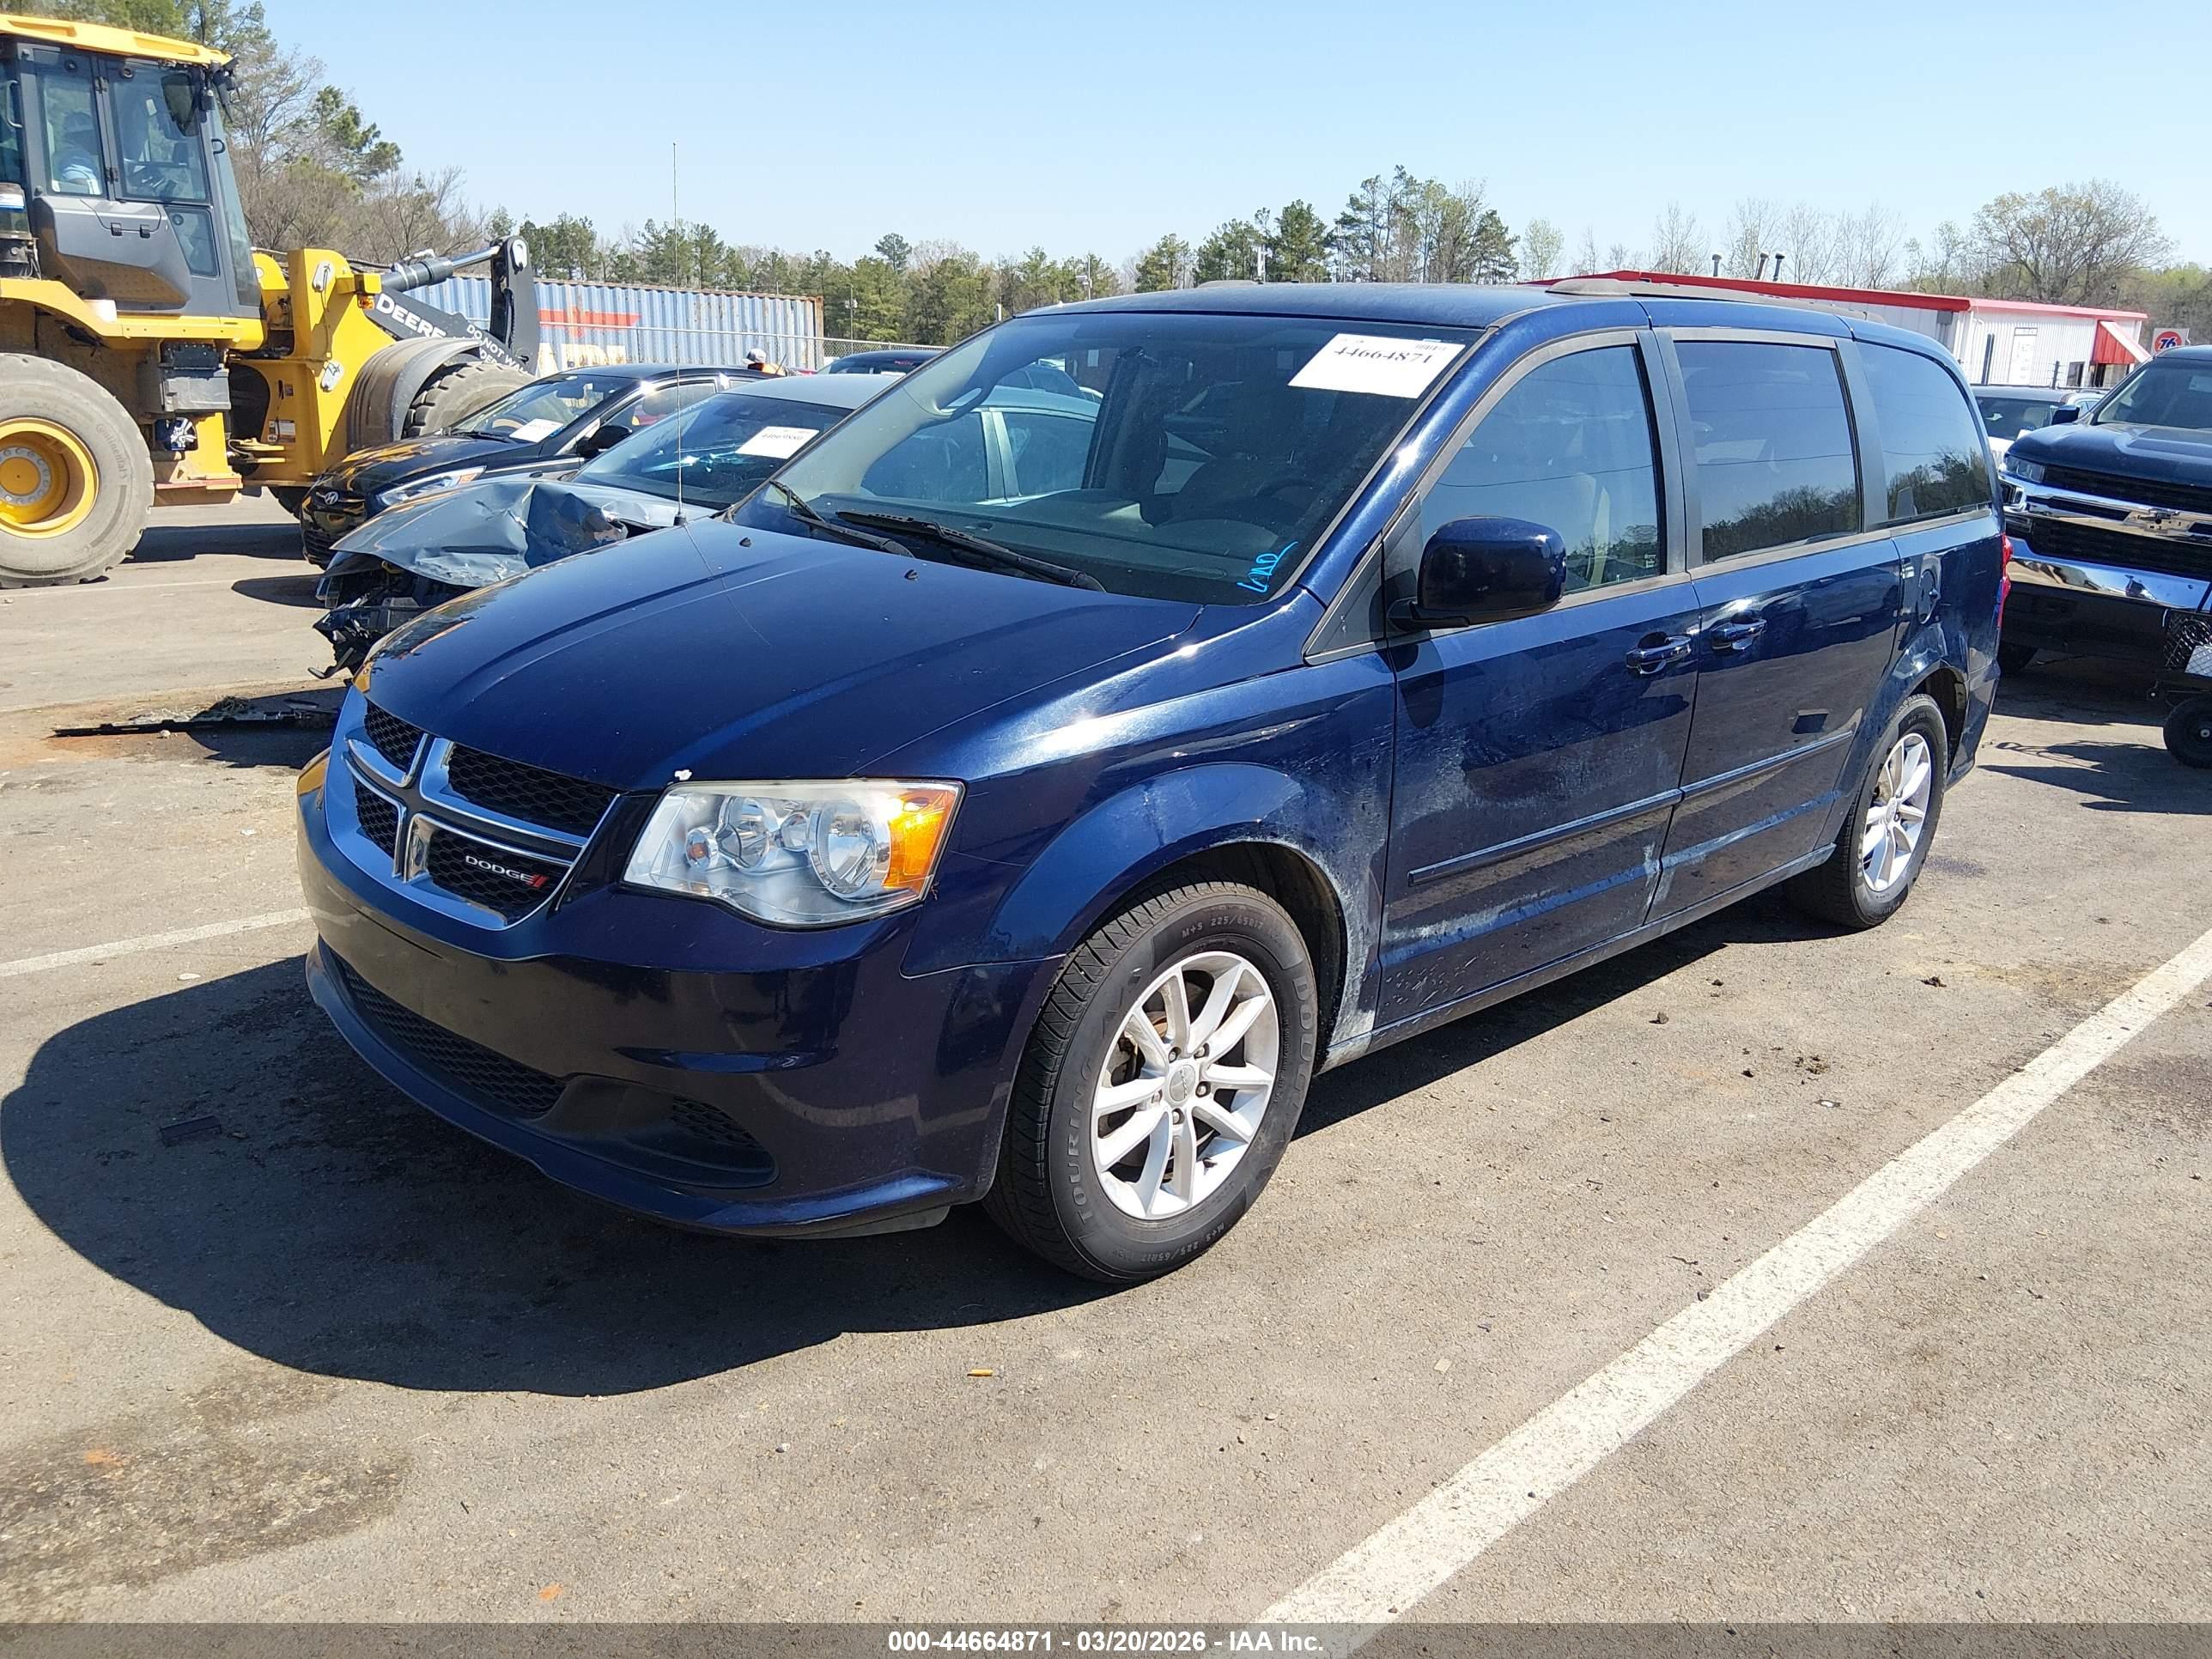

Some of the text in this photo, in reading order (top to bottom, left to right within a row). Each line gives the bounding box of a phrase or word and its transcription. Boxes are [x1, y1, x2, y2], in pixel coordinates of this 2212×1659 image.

[467, 325, 483, 340] DO
[483, 337, 505, 357] NOT
[2158, 337, 2179, 349] 76
[1334, 347, 1432, 363] 44664871
[465, 855, 534, 884] DODGE
[1210, 915, 1264, 931] 225/65R17
